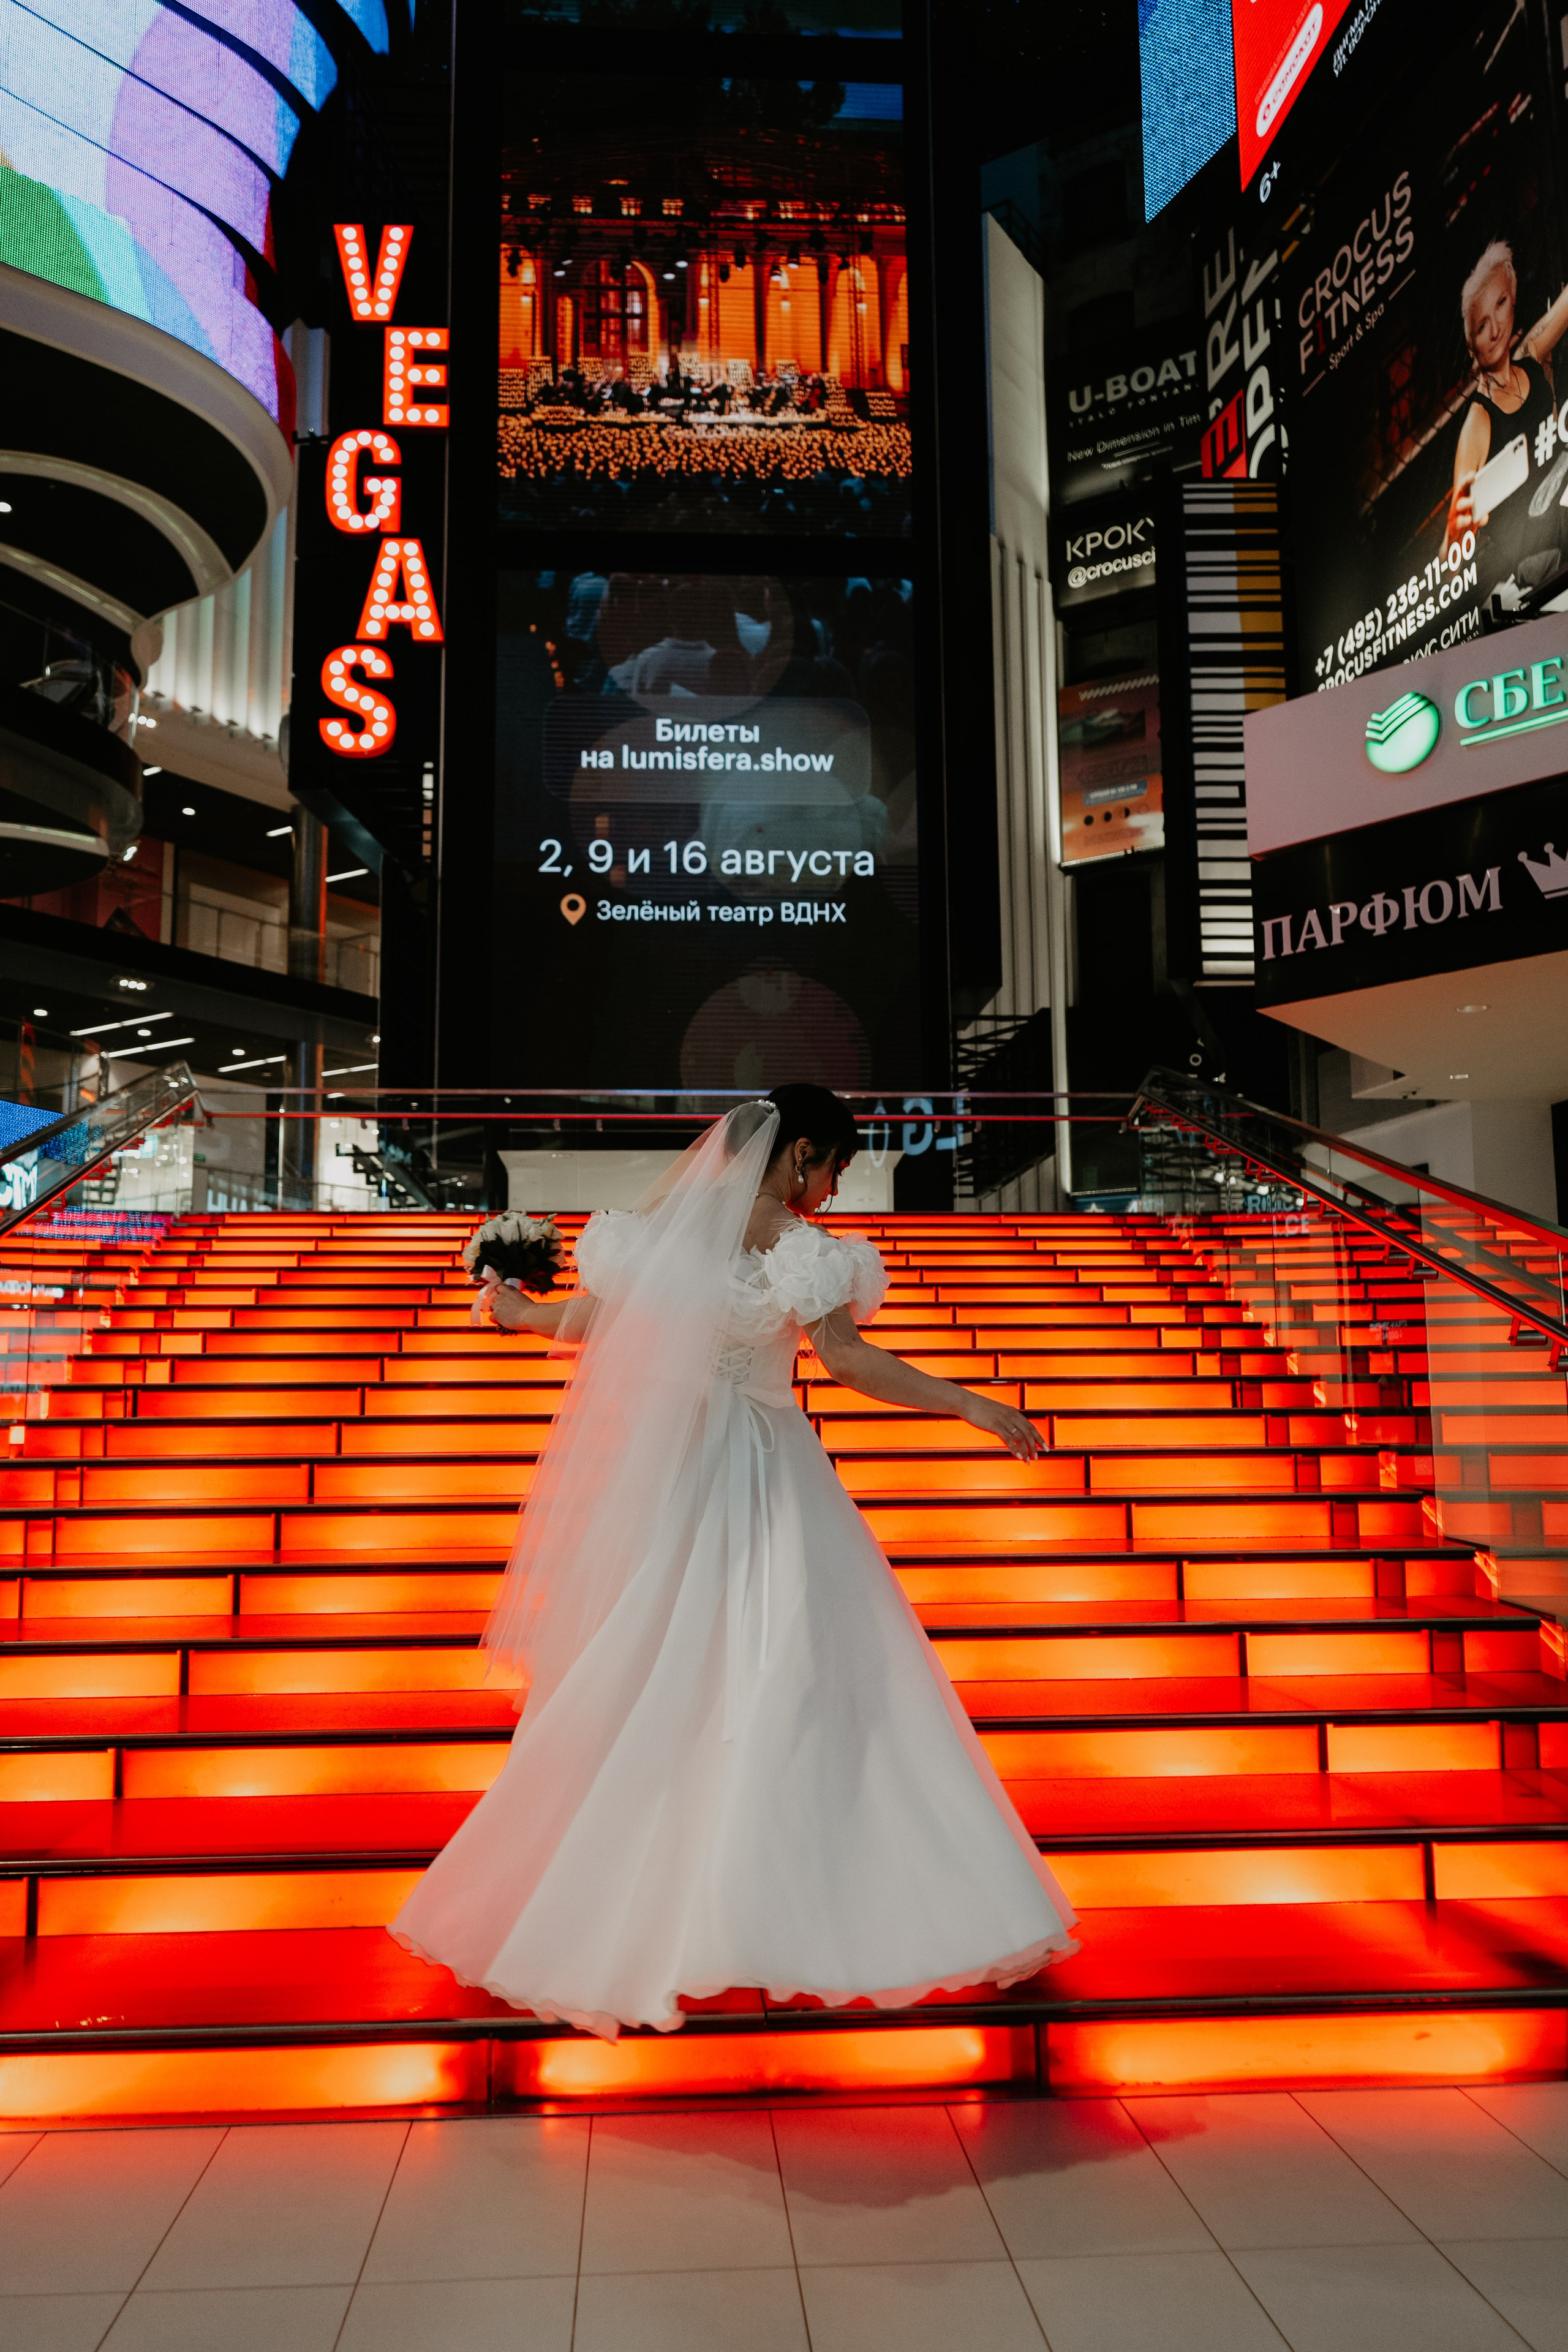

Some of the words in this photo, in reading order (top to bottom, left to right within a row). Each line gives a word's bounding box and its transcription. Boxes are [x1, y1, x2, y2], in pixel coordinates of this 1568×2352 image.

[1349, 0, 1383, 54] ВОРОН
[1259, 161, 1281, 203] 6+
[1298, 170, 1411, 329] CROCUS
[1329, 334, 1354, 371] Sport
[1355, 323, 1363, 342] &
[1365, 303, 1385, 330] Spa
[1068, 350, 1197, 414] U-BOAT
[1069, 407, 1116, 428] ITALO
[1127, 383, 1199, 410] FONTAN
[1067, 447, 1094, 462] New
[1096, 426, 1161, 454] Dimension
[1163, 421, 1175, 434] in
[319, 224, 450, 758] VEGAS
[1315, 644, 1334, 677] +7
[1337, 607, 1383, 665] (495)
[1386, 530, 1476, 625] 236-11-00
[1440, 606, 1480, 649] СИТИ
[655, 718, 760, 744] Билеты
[580, 748, 614, 769] на
[622, 745, 834, 772] lumisfera.show
[538, 839, 573, 878] 2,
[587, 839, 613, 874] 9
[628, 848, 650, 874] и
[663, 840, 707, 875] 16
[720, 849, 875, 883] августа
[596, 900, 701, 921] Зелёный
[707, 905, 774, 926] театр
[780, 902, 847, 926] ВДНХ
[1262, 866, 1504, 961] ПАРФЮМ
